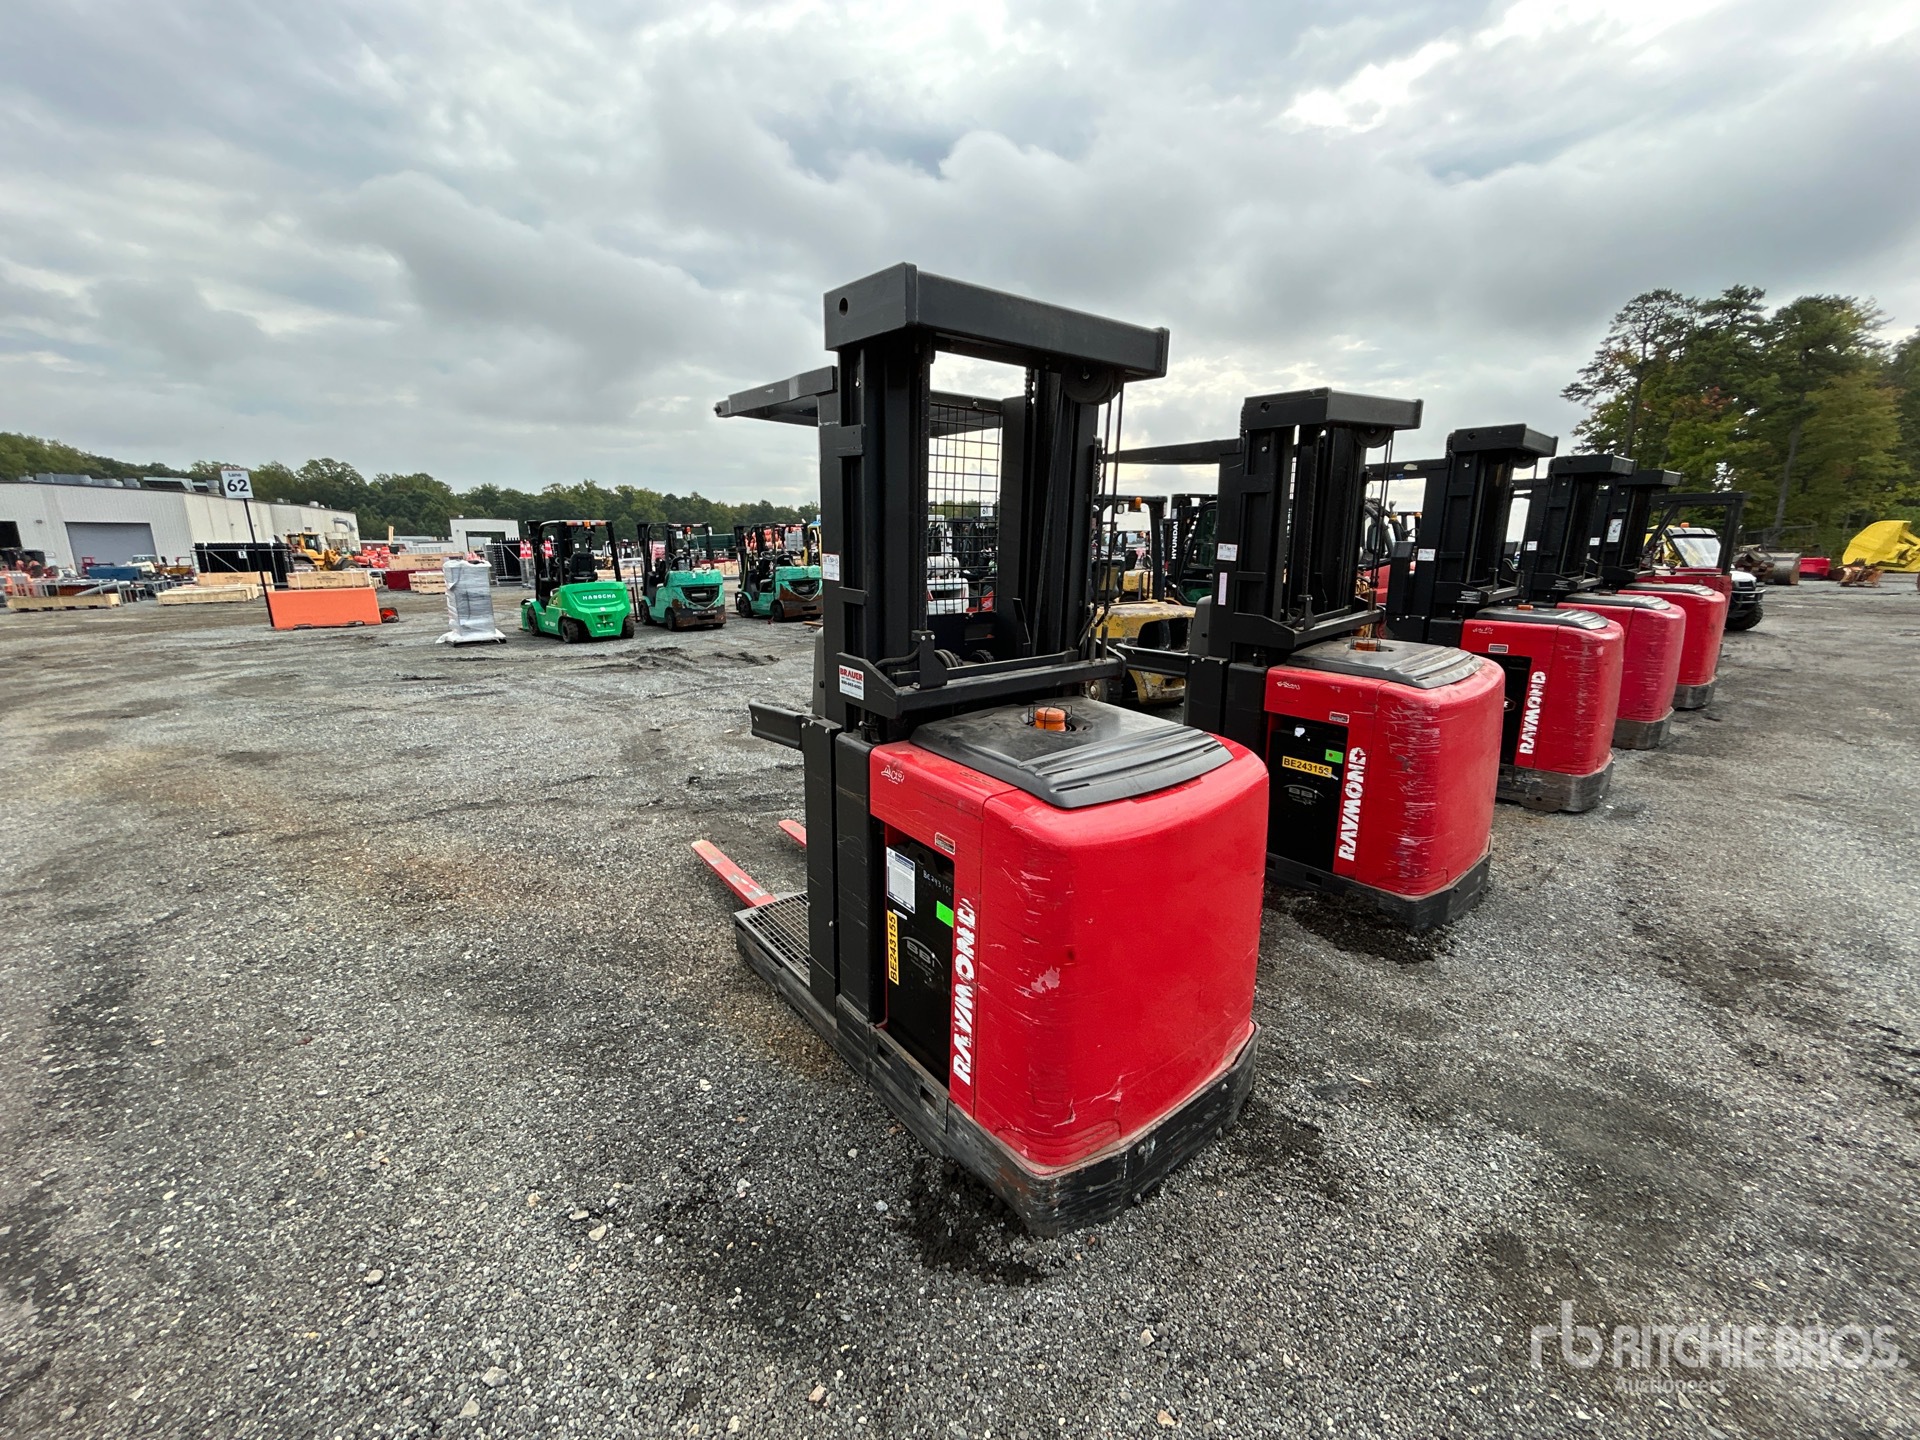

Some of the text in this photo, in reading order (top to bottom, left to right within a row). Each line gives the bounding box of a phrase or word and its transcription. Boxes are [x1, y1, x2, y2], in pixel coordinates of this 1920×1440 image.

[227, 479, 249, 492] 62
[1171, 521, 1179, 560] HYUNDAI
[840, 667, 863, 682] BRAUER
[1519, 671, 1547, 754] RAYMOND
[1338, 747, 1367, 861] RAYMOND
[889, 916, 898, 982] BE243155
